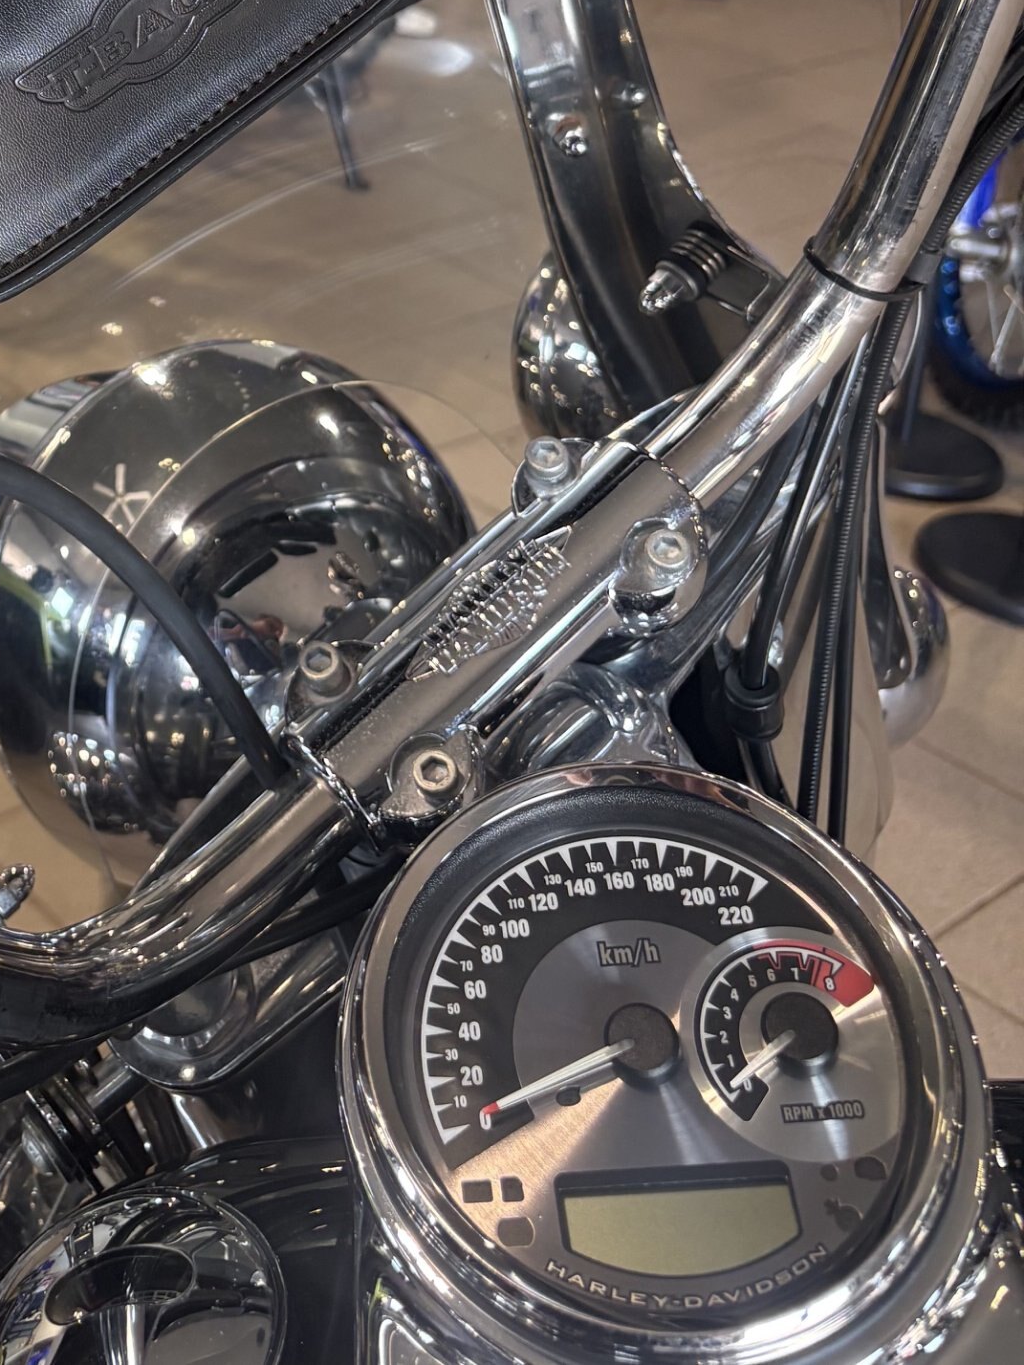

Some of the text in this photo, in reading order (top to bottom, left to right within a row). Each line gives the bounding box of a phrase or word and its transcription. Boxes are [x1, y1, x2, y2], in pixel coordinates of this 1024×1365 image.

[585, 861, 604, 873] 150
[631, 858, 649, 870] 170
[544, 873, 562, 885] 130
[675, 866, 693, 878] 190
[565, 877, 596, 896] 140
[604, 872, 635, 890] 160
[643, 873, 674, 892] 180
[681, 887, 715, 906] 200
[719, 885, 739, 897] 210
[507, 897, 525, 909] 110
[528, 892, 558, 912] 120
[718, 906, 754, 925] 220
[482, 924, 495, 936] 90
[499, 919, 530, 939] 100
[480, 944, 503, 964] 80
[597, 938, 661, 968] km/h
[460, 960, 473, 972] 70
[748, 975, 757, 988] 5
[767, 968, 776, 982] 6
[464, 980, 487, 999] 60
[825, 976, 836, 991] 8
[730, 988, 740, 1002] 4
[447, 1003, 461, 1014] 50
[723, 1006, 732, 1020] 3
[458, 1021, 481, 1041] 40
[719, 1031, 729, 1044] 2
[445, 1049, 458, 1060] 30
[727, 1054, 735, 1067] 1
[460, 1065, 483, 1086] 20
[454, 1095, 467, 1108] 10
[782, 1102, 864, 1123] RPM x 1000
[546, 1245, 827, 1308] HARLEY-DAVIDSON
